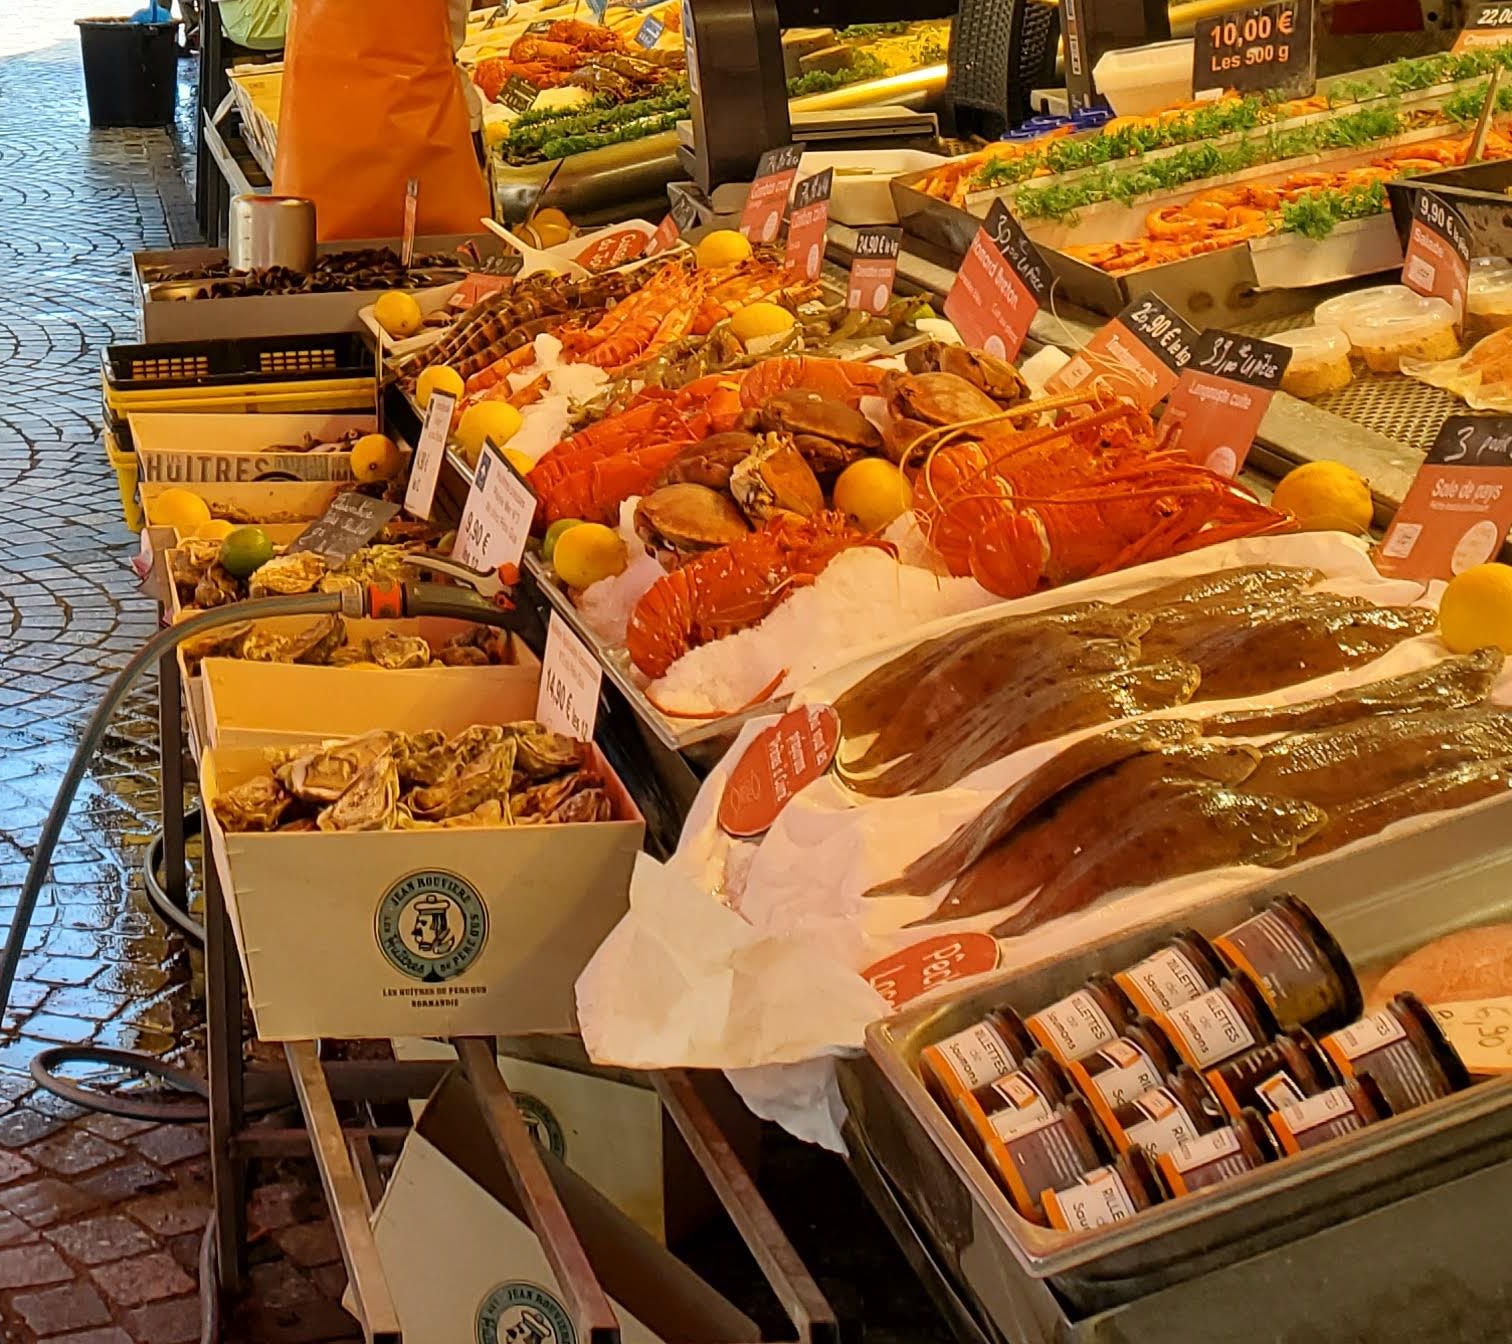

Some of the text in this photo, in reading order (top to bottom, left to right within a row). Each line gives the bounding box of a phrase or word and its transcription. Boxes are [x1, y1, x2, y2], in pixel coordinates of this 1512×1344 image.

[1210, 10, 1293, 49] 10,00 €
[1211, 45, 1289, 72] Les 500 g
[1420, 196, 1445, 228] 9,90
[1446, 215, 1454, 236] €
[857, 235, 879, 255] 24,90
[1160, 327, 1181, 348] €
[1167, 338, 1181, 355] le
[1175, 345, 1192, 367] kg
[1443, 426, 1475, 462] 3
[1431, 478, 1504, 505] Sole de pays
[465, 511, 491, 556] 9,90 €
[546, 666, 567, 712] 14,90
[391, 881, 415, 907] JEAN
[411, 999, 459, 1008] NORMANDIE
[1046, 1012, 1076, 1050] Saumons
[1179, 1011, 1209, 1054] Saumons
[949, 1043, 979, 1085] Saumons
